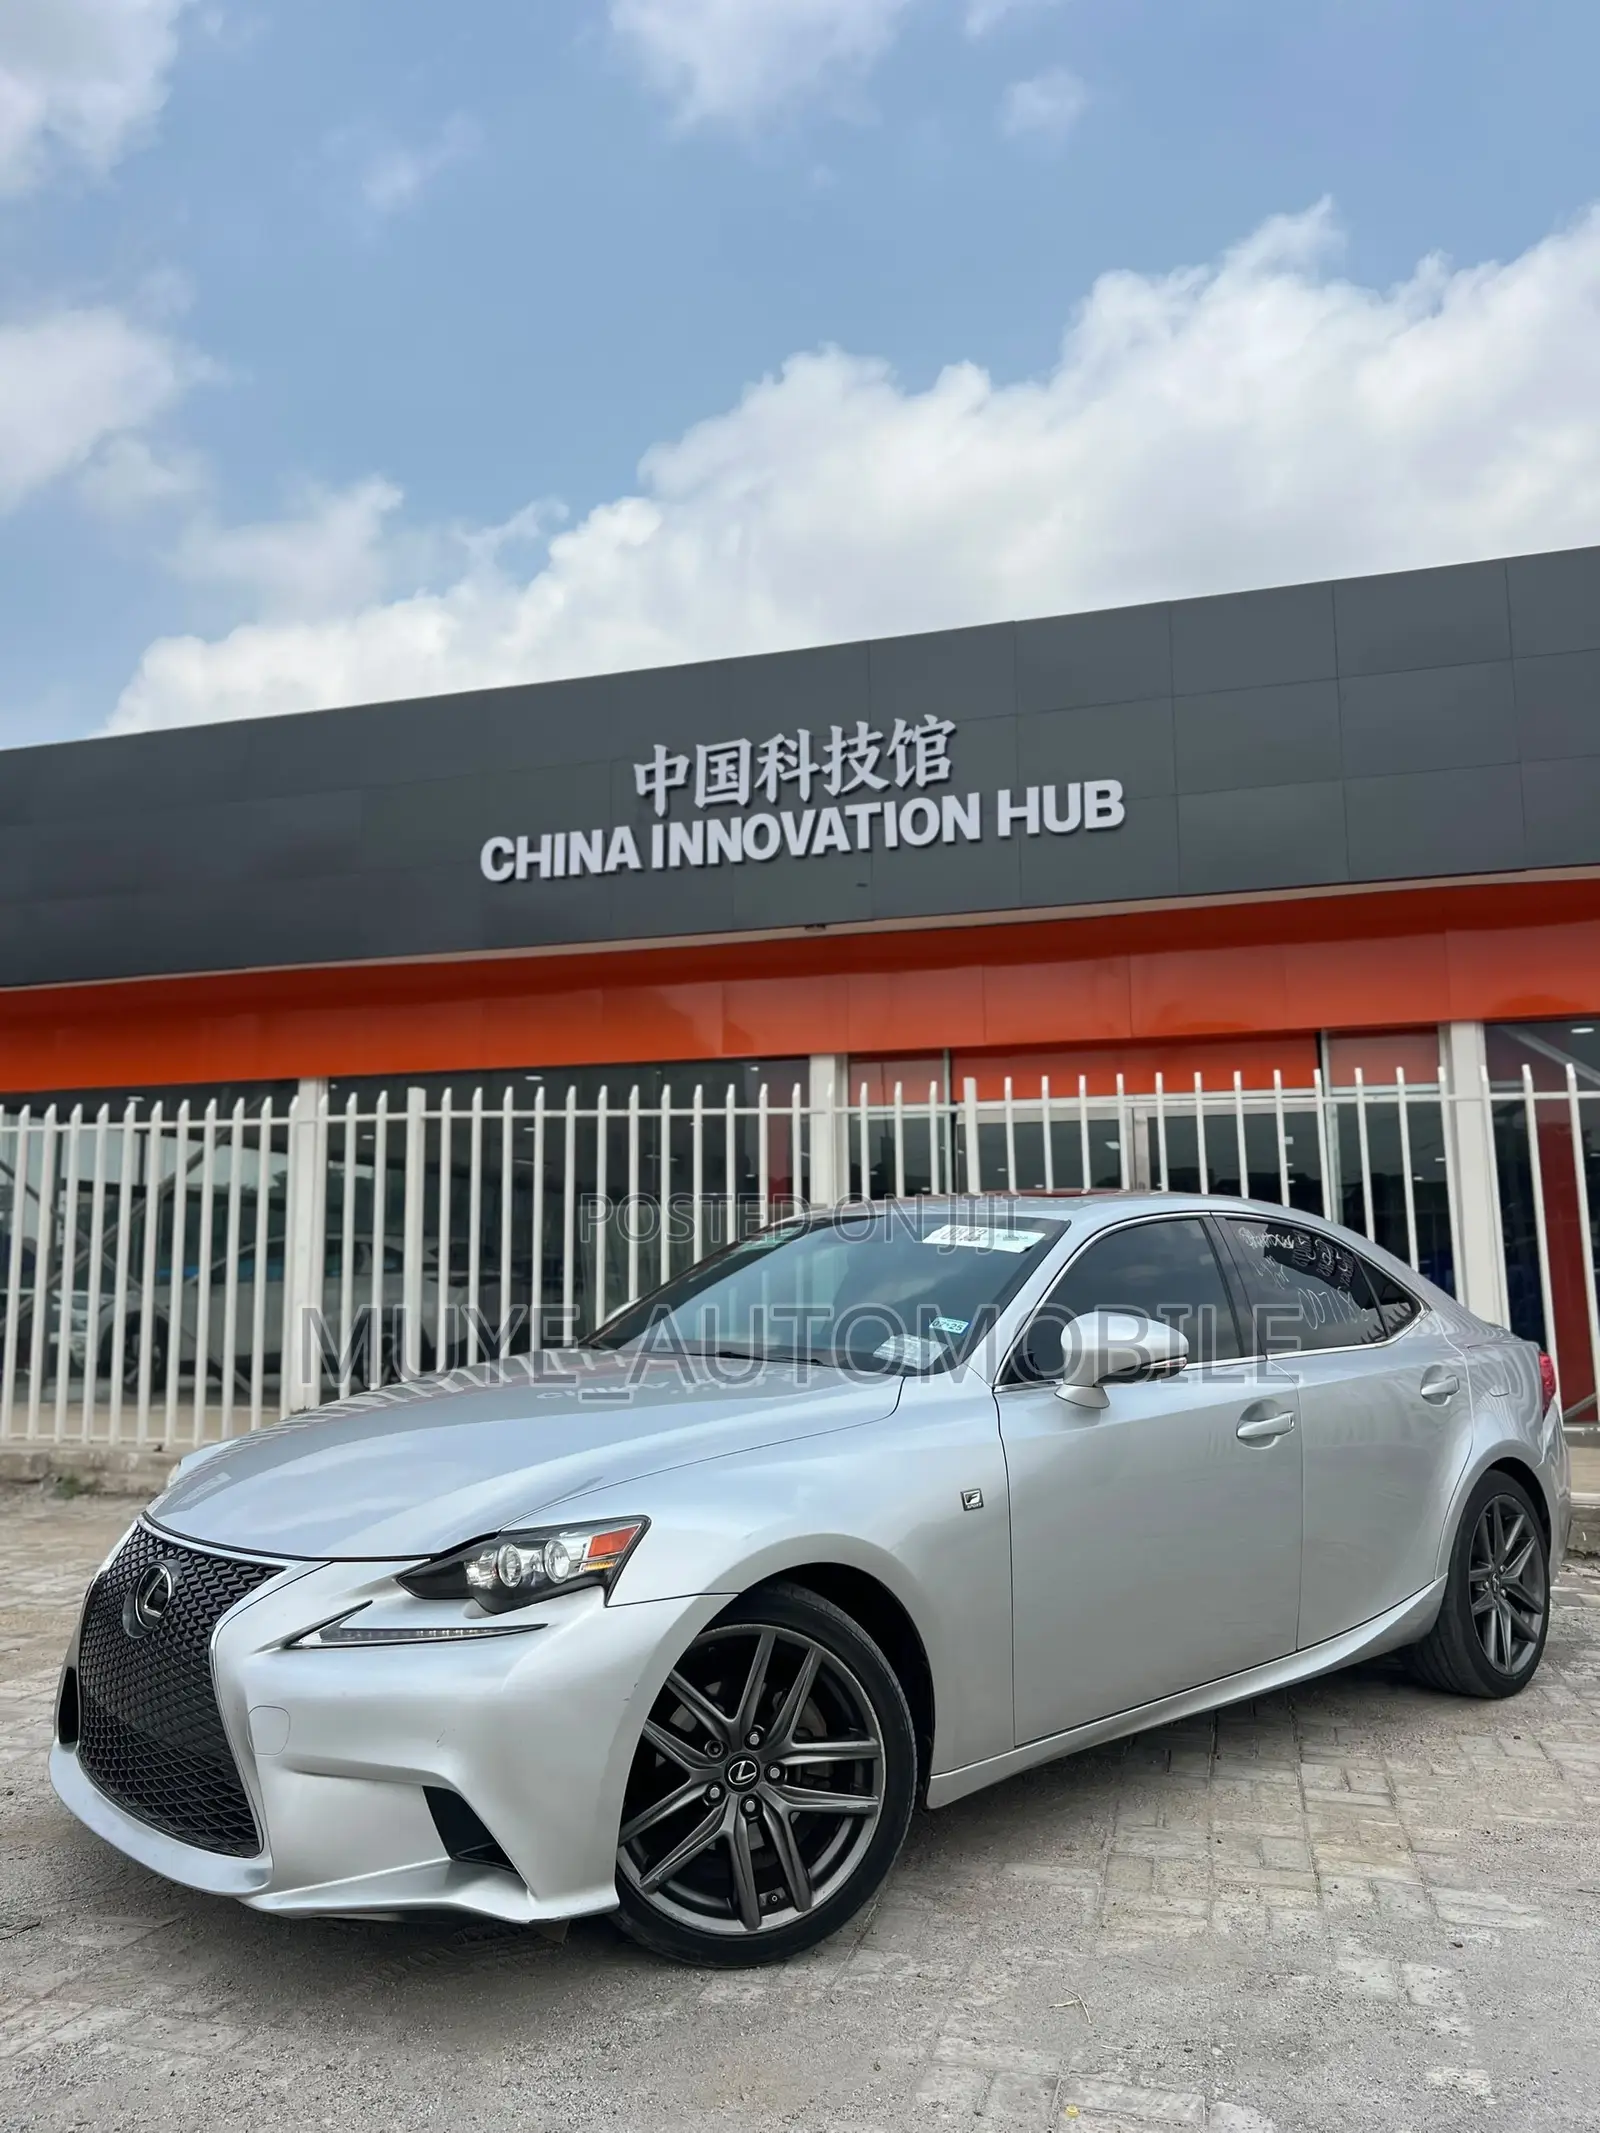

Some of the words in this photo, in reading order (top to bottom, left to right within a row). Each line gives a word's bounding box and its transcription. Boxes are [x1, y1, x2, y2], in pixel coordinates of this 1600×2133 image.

[633, 714, 957, 818] 中国科技馆
[480, 825, 644, 883] CHINA
[651, 792, 982, 870] INNOVATION
[997, 779, 1126, 838] HUB
